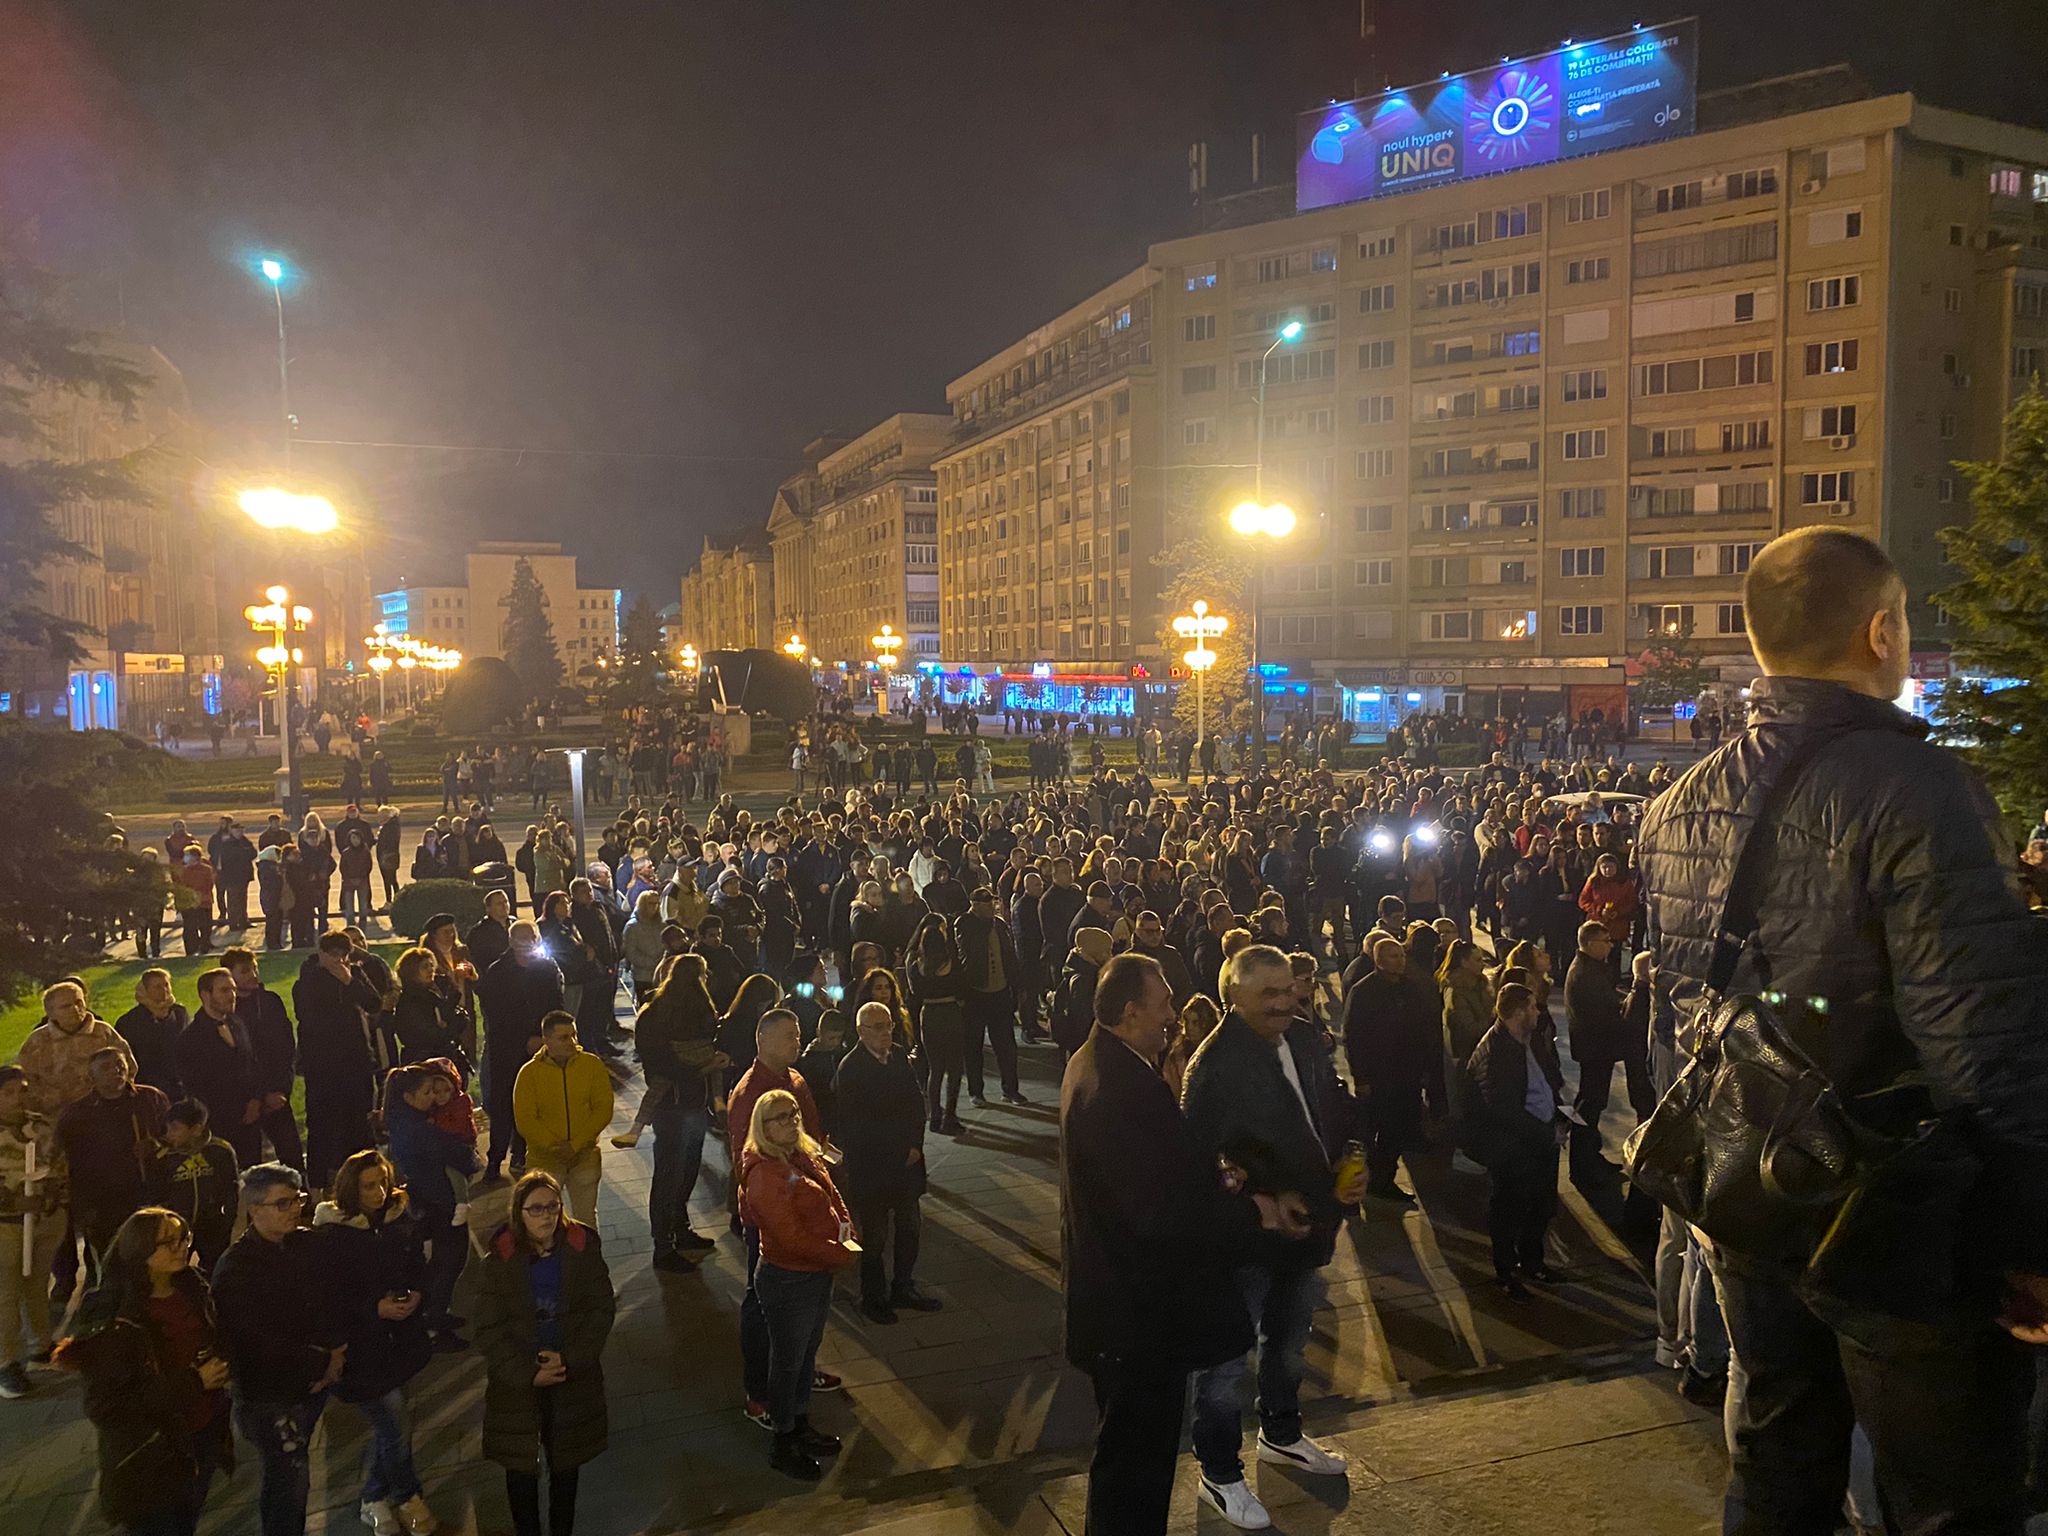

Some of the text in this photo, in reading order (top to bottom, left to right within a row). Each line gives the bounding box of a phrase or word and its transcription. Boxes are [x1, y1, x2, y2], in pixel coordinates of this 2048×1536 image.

[1578, 50, 1625, 68] LATERALE
[1626, 36, 1678, 56] COLORATE
[1568, 71, 1579, 81] 76
[1580, 67, 1593, 78] DE
[1654, 104, 1681, 127] glo
[1383, 128, 1454, 153] noul hyper+
[1381, 143, 1456, 178] UNIQ
[173, 1166, 213, 1182] adidas
